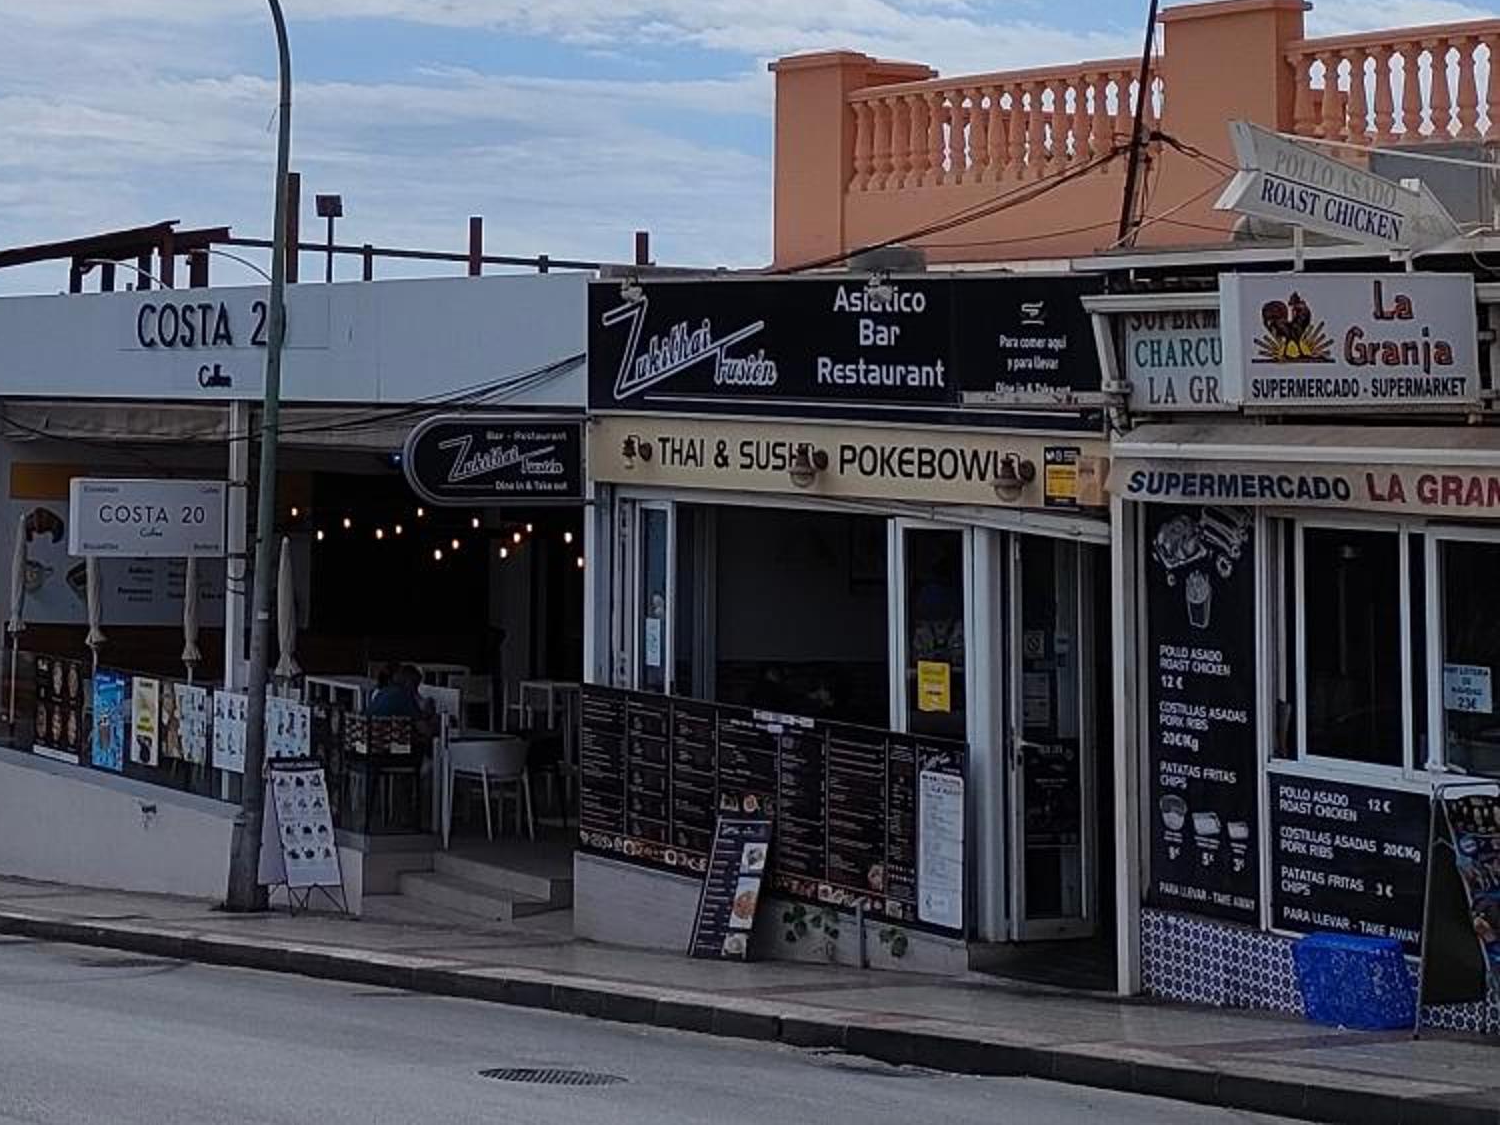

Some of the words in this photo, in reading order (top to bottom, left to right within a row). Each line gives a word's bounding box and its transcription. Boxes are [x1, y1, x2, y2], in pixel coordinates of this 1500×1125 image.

[1260, 178, 1321, 215] ROAST
[1323, 201, 1403, 242] CHICKEN
[1373, 280, 1414, 321] La
[137, 302, 232, 347] COSTA
[251, 301, 287, 346] 2
[859, 318, 901, 346] Bar
[1135, 336, 1223, 368] CHARCU
[1344, 326, 1454, 373] Granja
[817, 356, 945, 387] Restaurant
[1148, 376, 1177, 404] LA
[1251, 379, 1360, 398] SUPERMERCADO
[1371, 377, 1467, 397] SUPERMARKET
[658, 437, 705, 467] THAI
[714, 440, 729, 468] &
[739, 441, 802, 471] SUSH
[1127, 470, 1351, 502] SUPERMERCADO
[1366, 472, 1406, 503] LA
[100, 505, 168, 524] COSTA
[182, 506, 205, 524] 20
[1161, 674, 1175, 688] 12
[1279, 786, 1311, 801] POLLO
[1312, 790, 1349, 807] ASADO
[1367, 798, 1382, 812] 12
[1279, 799, 1313, 815] ROAST
[1315, 804, 1358, 822] CHICKEN
[1279, 826, 1332, 845] COSTILLAS
[1334, 834, 1377, 852] ASADAS
[1280, 838, 1307, 854] PORK
[1309, 844, 1334, 860] RIBS
[1280, 865, 1325, 885] PATATAS
[1327, 874, 1365, 892] FRITAS
[1280, 880, 1311, 896] CHIPS
[1283, 906, 1311, 923] PARA
[1312, 911, 1350, 930] LLEVAR
[1359, 920, 1387, 936] TAKE
[1389, 925, 1421, 943] AWAY
